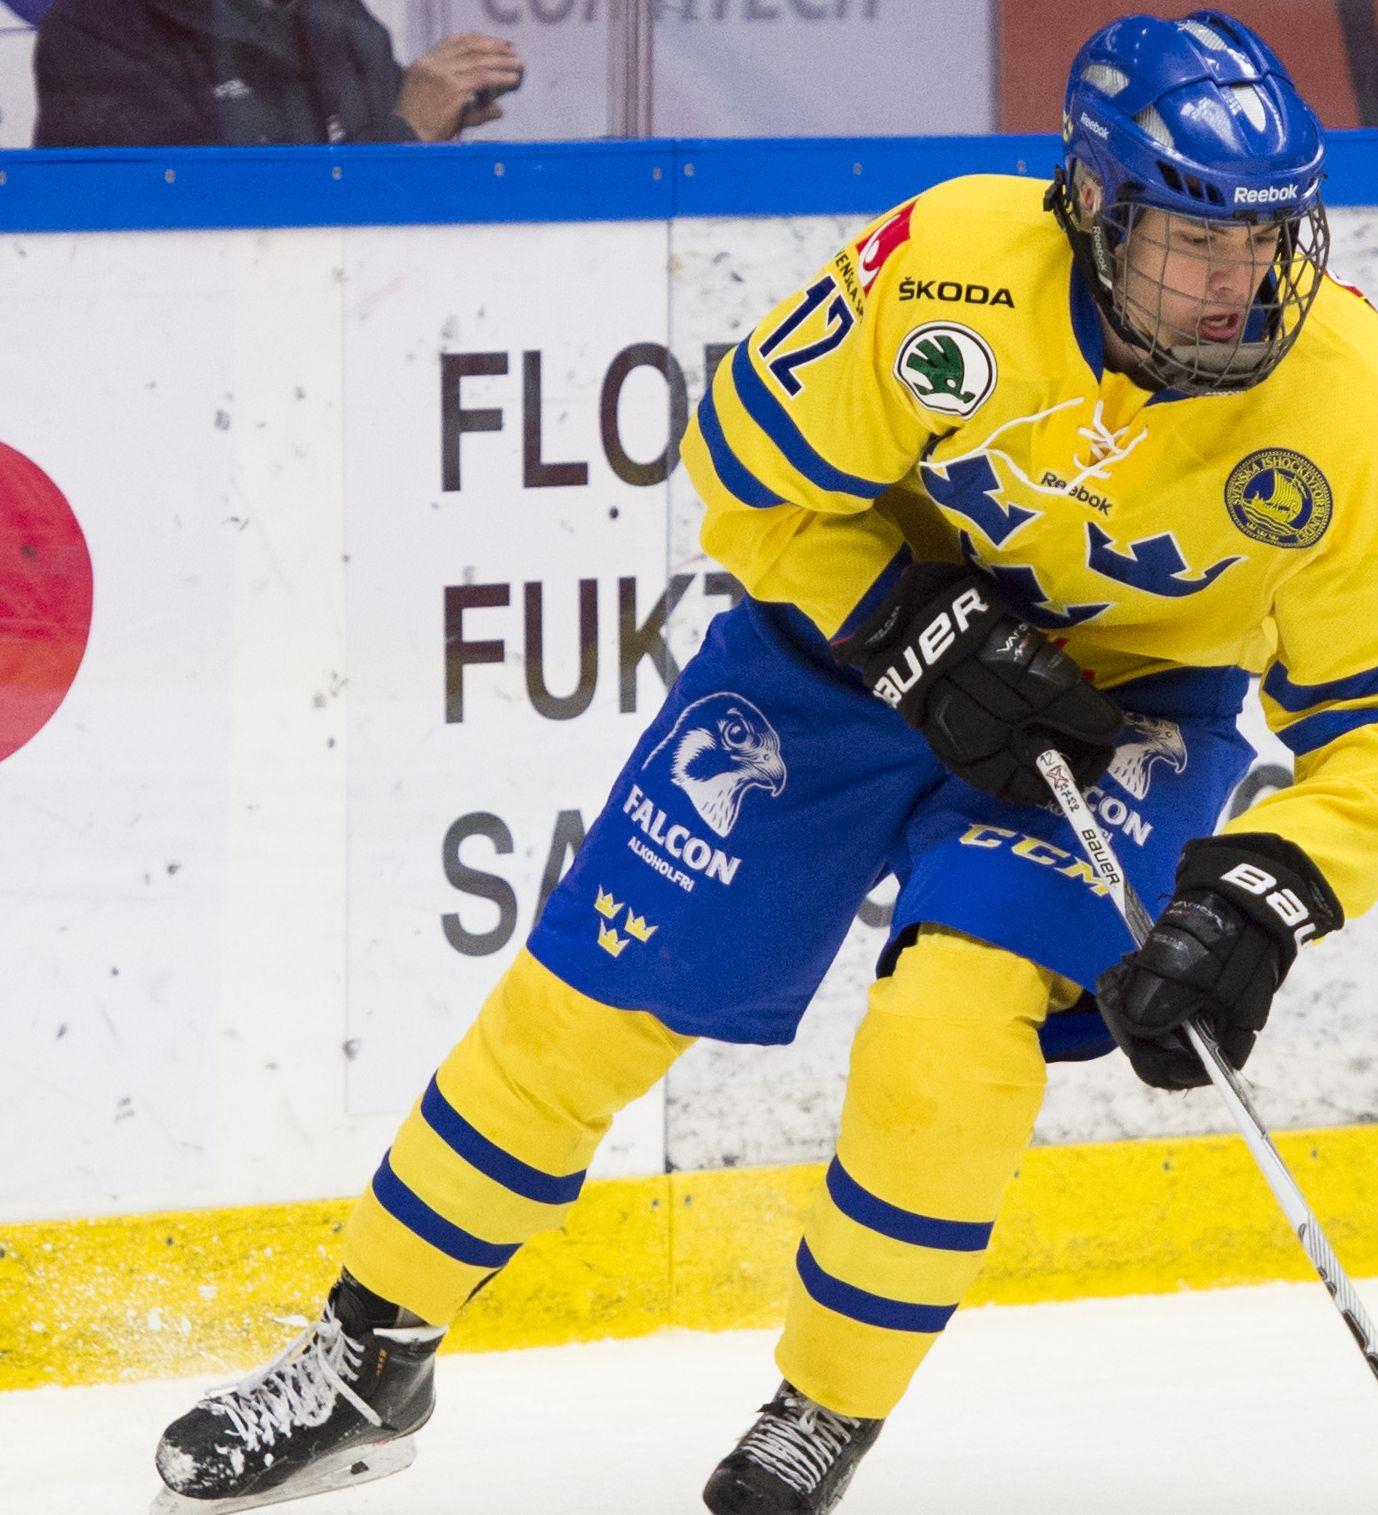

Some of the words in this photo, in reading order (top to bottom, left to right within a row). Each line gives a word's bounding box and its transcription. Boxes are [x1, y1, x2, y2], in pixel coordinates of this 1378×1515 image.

[1080, 110, 1111, 140] Reebok
[1233, 182, 1300, 204] Reebok
[898, 277, 1016, 309] ŠKODA
[757, 272, 855, 398] 12
[440, 341, 742, 491] FLO
[622, 783, 743, 886] FALCON
[627, 835, 696, 893] ALKOHOLFRI
[958, 823, 1110, 897] CCM
